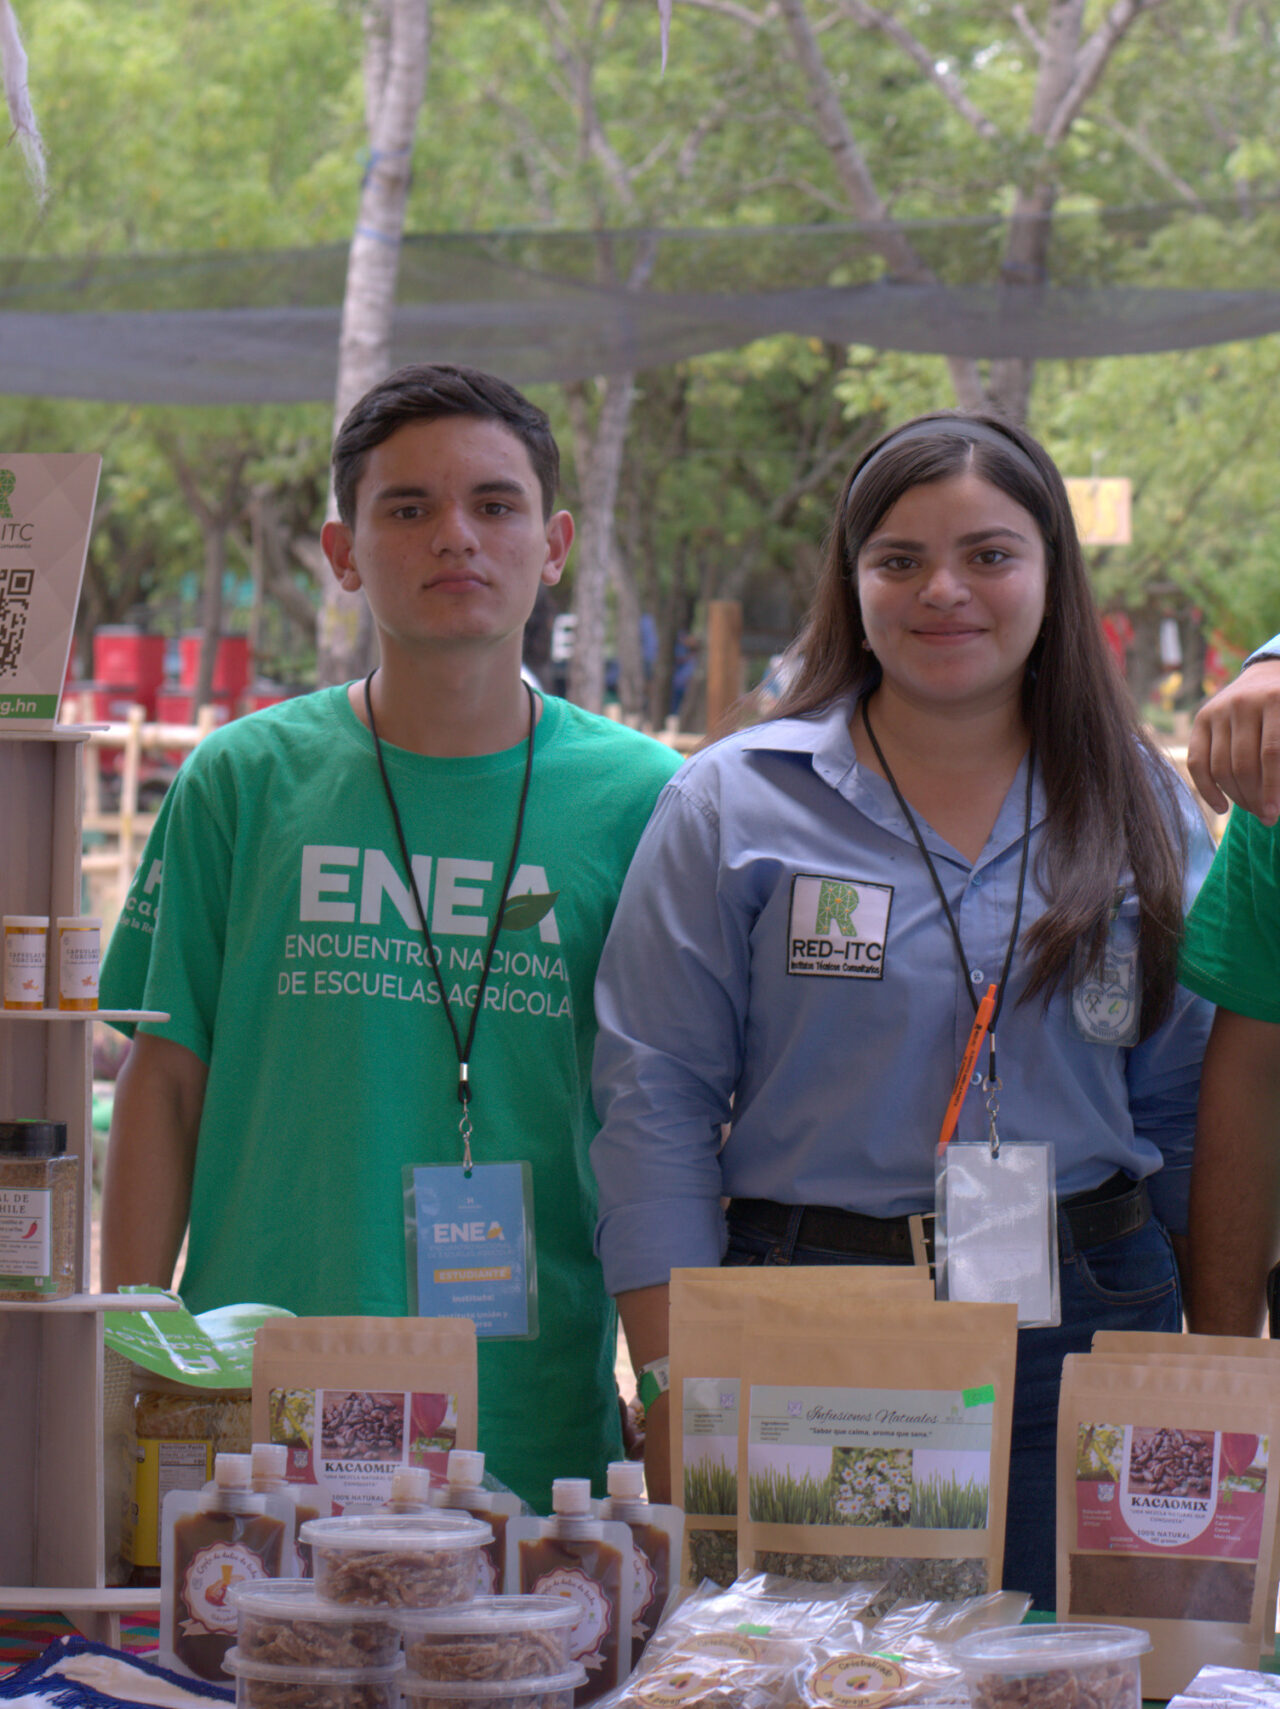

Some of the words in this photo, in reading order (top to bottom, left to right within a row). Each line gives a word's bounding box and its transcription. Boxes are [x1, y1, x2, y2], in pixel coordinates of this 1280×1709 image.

[300, 844, 561, 945] ENEA
[285, 934, 441, 968] ENCUENTRO
[450, 947, 570, 982] NACIONAL
[792, 939, 882, 961] RED-ITC
[278, 971, 307, 995] DE
[314, 970, 441, 1005] ESCUELAS
[448, 982, 572, 1018] AGRÍCOLA
[0, 1205, 26, 1214] HILE
[14, 1194, 29, 1203] DE
[434, 1221, 505, 1244] ENEA
[1131, 1496, 1208, 1511] KACAOMIX
